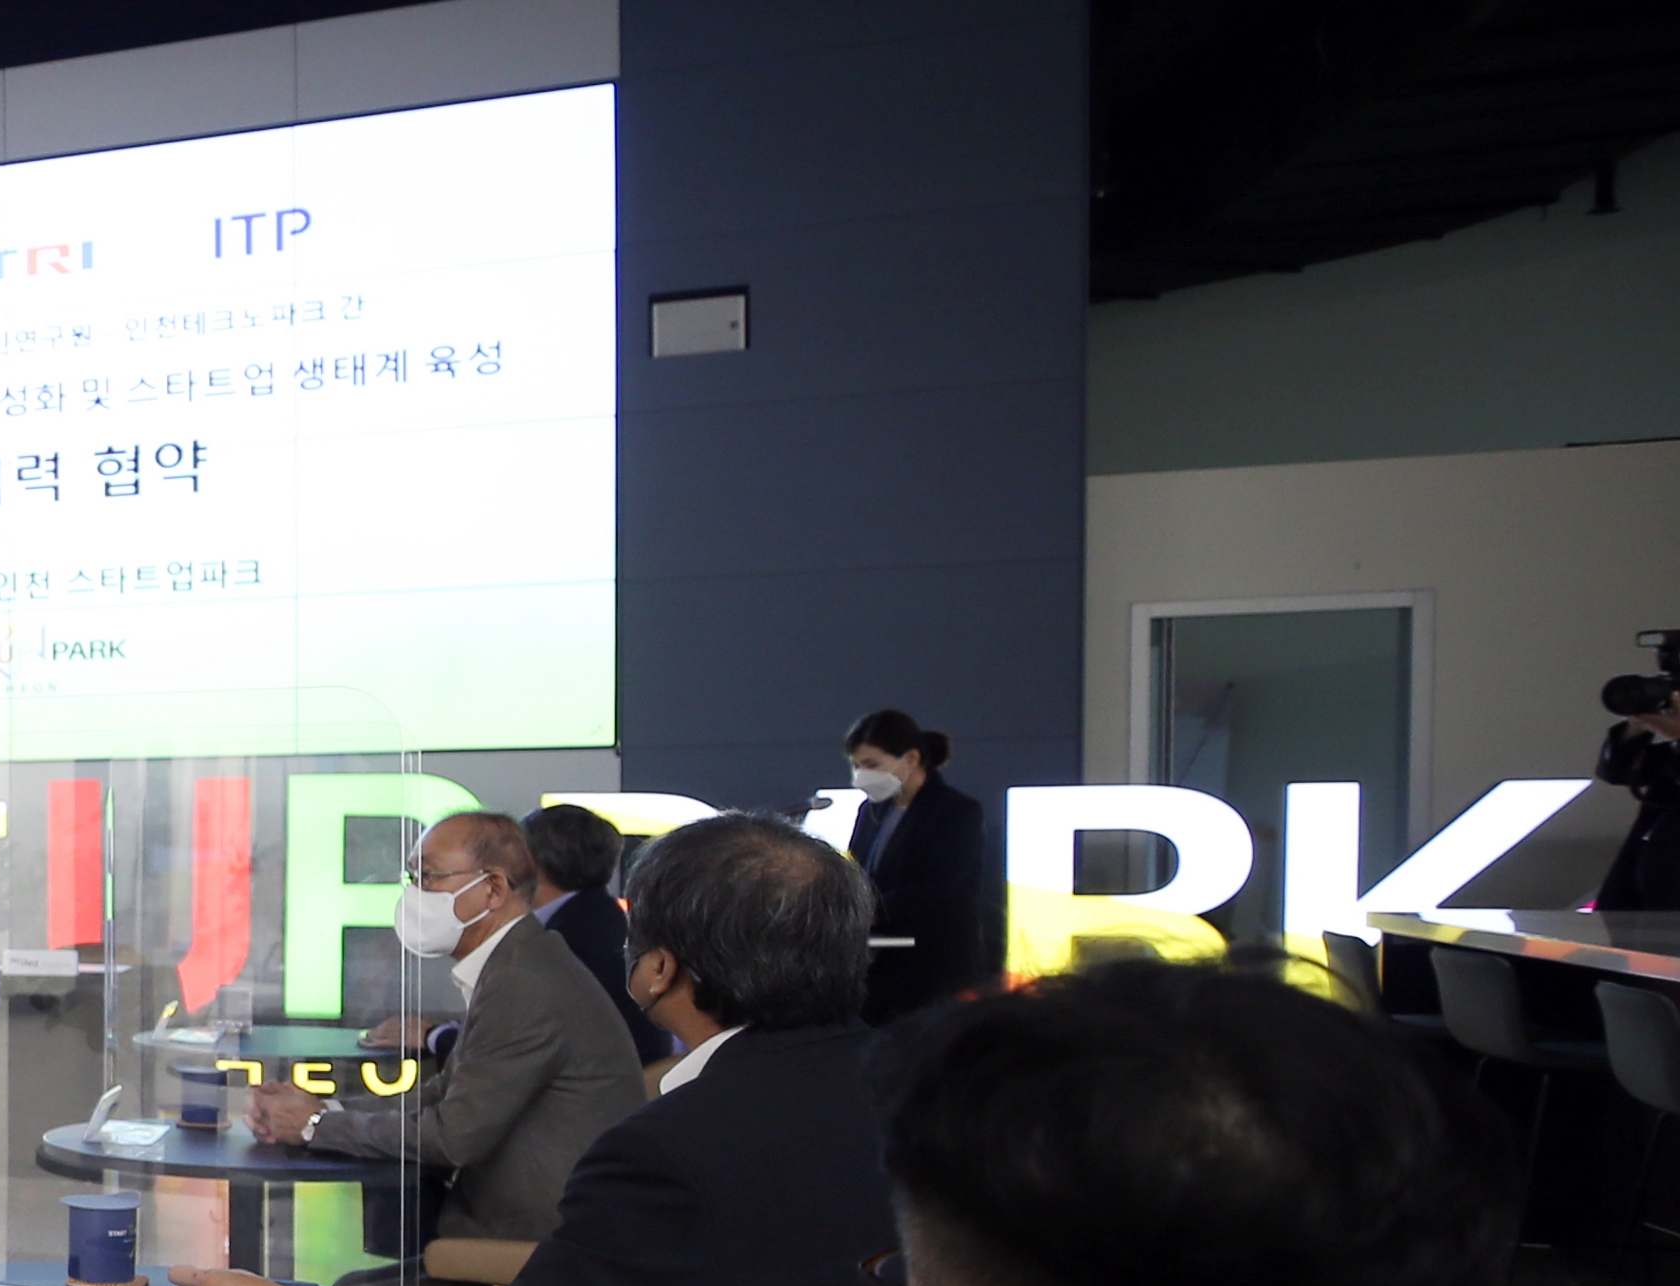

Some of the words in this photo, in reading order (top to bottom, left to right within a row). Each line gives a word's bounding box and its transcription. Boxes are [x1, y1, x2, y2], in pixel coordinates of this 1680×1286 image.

[215, 207, 312, 259] ITP
[126, 300, 326, 341] 인천테크노파크
[340, 294, 365, 321] 간
[82, 377, 110, 411] 및
[127, 361, 274, 403] 스타트업
[293, 348, 408, 391] 생태계
[425, 340, 502, 379] 육성
[93, 438, 209, 498] 협약
[67, 558, 265, 594] 스타트업파크
[52, 637, 129, 662] PARK
